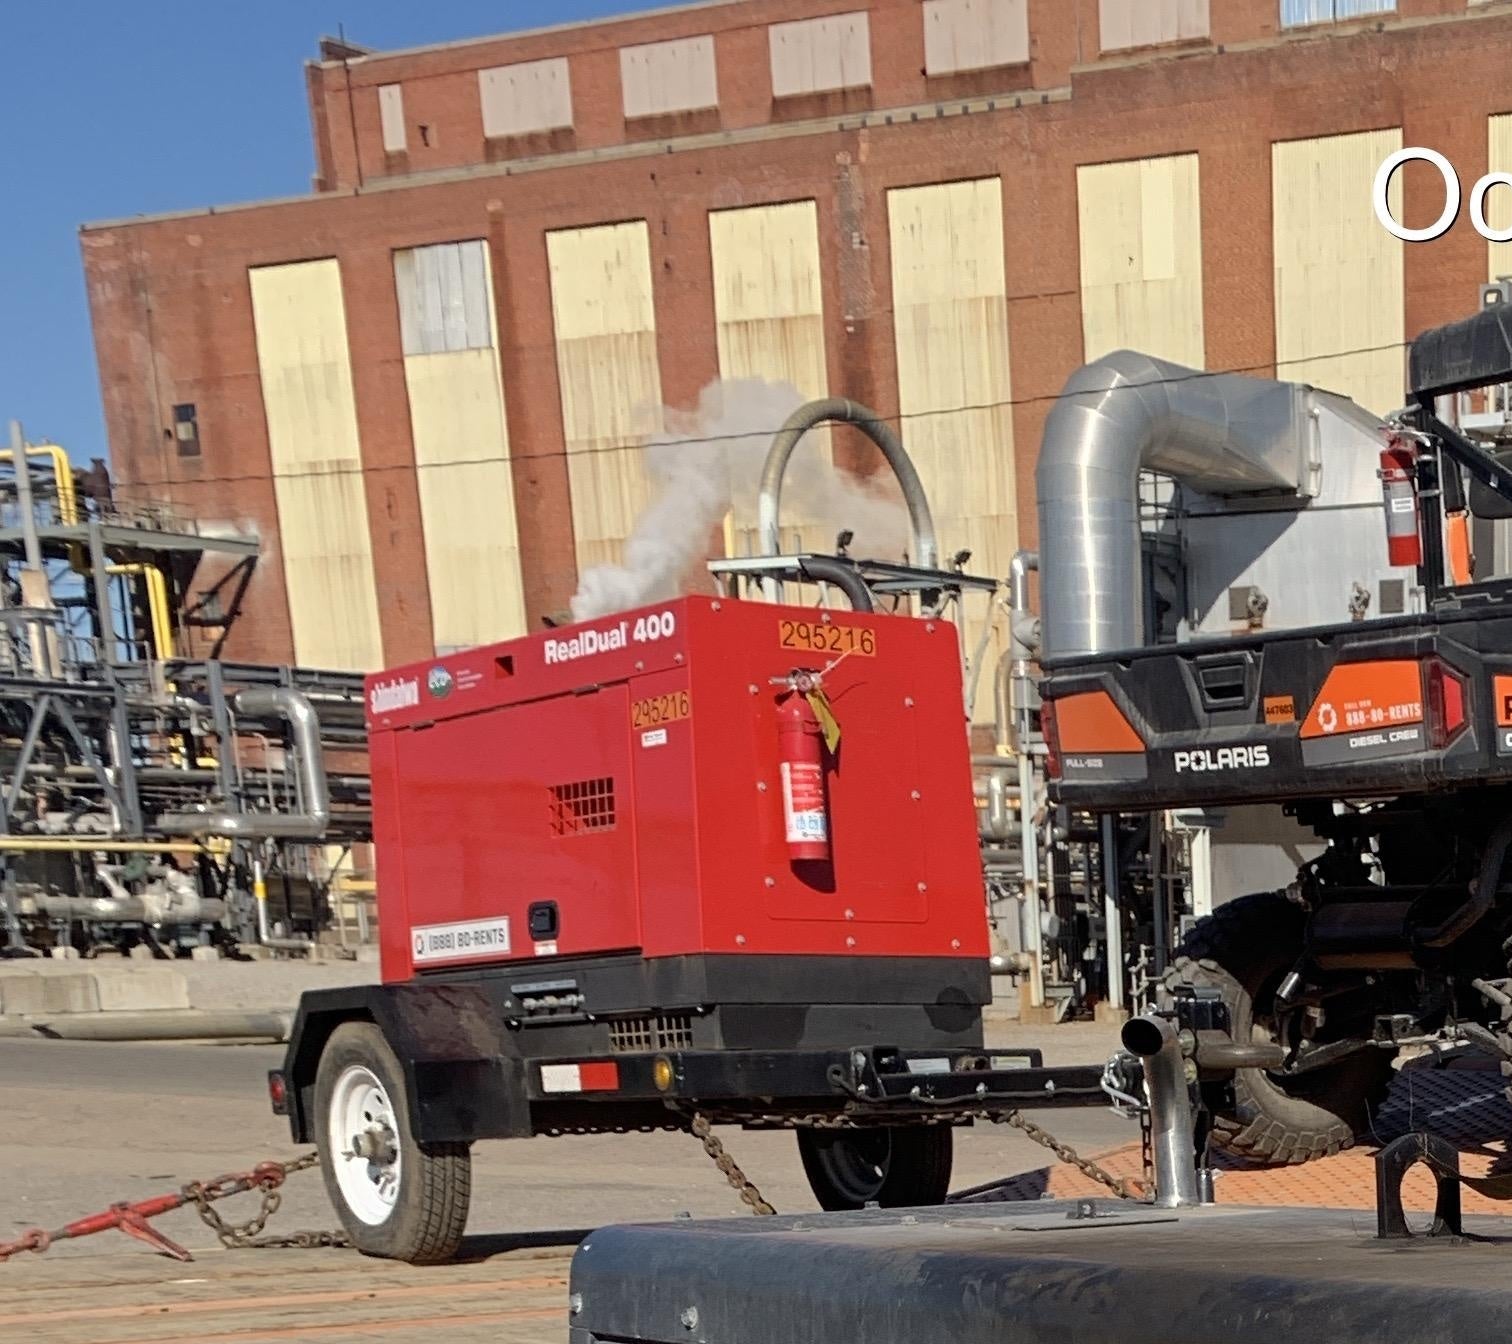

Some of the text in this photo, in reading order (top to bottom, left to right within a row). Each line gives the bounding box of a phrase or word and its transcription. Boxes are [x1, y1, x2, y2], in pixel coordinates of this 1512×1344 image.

[544, 611, 676, 664] RealDual 400
[781, 620, 875, 655] 295216
[633, 691, 689, 728] 295216
[1346, 702, 1421, 726] 888-80-RENTS
[1349, 729, 1418, 748] DIESEL CREW
[1174, 746, 1270, 773] POLARIS
